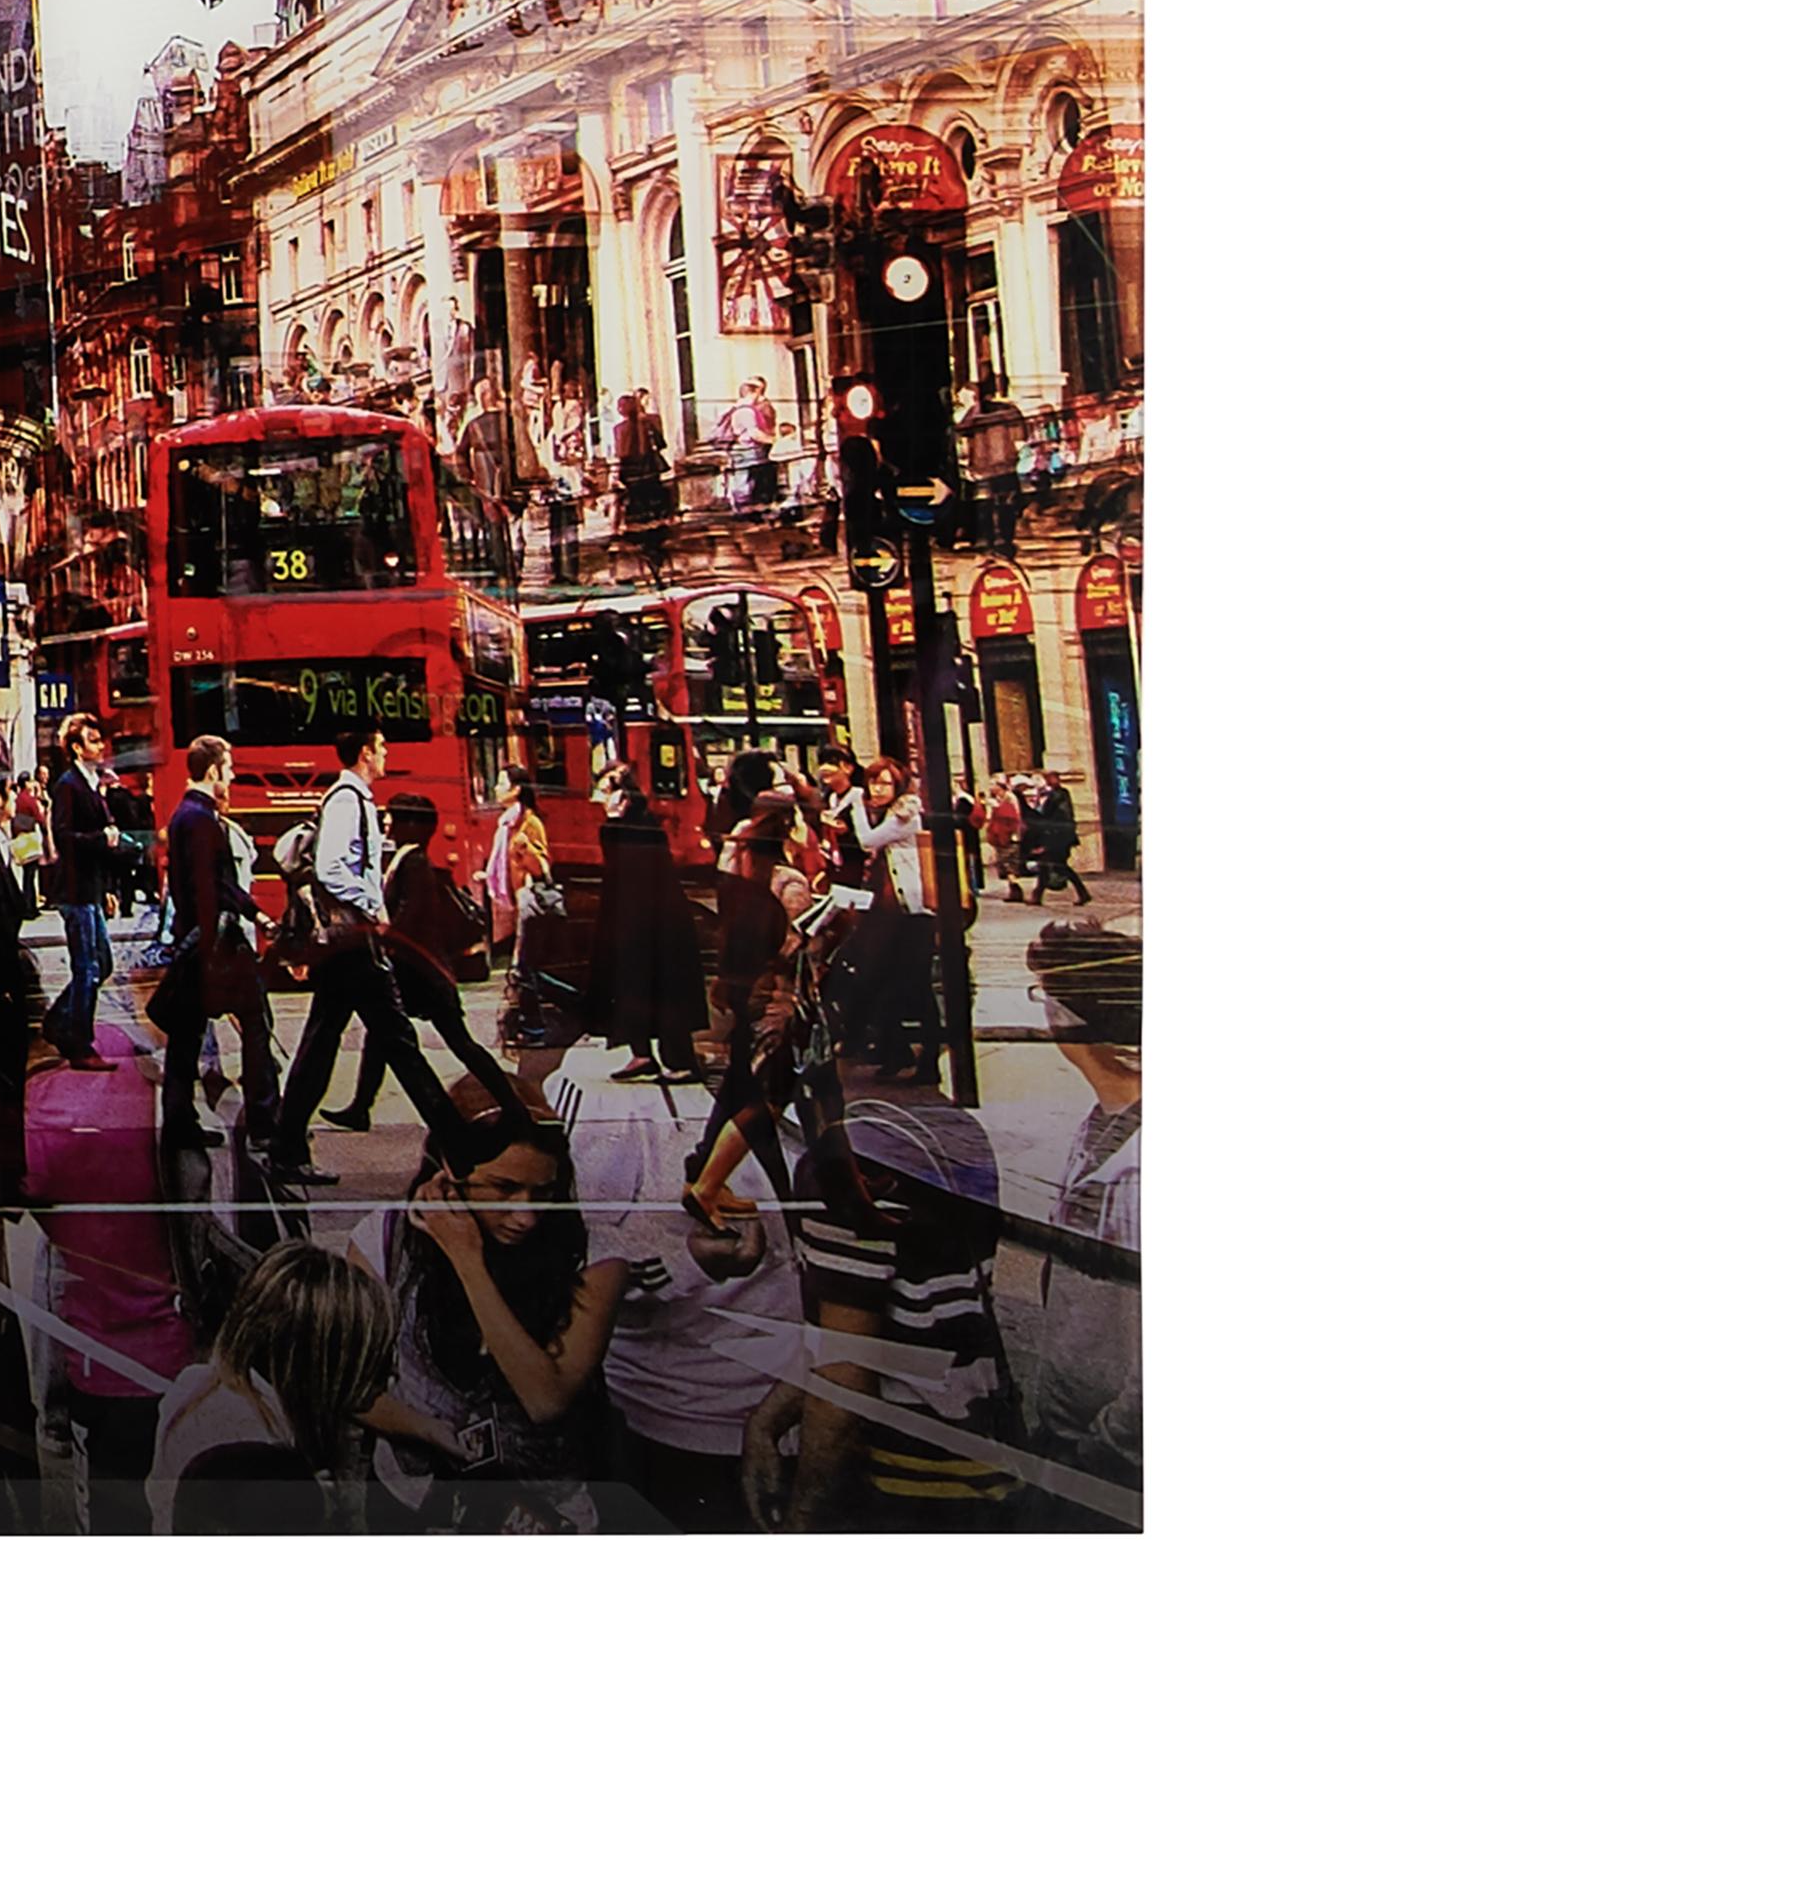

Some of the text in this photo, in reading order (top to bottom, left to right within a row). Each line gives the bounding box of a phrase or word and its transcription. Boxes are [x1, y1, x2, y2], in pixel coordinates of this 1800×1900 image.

[270, 549, 308, 581] 38
[39, 682, 69, 709] GAP
[328, 687, 358, 716] via
